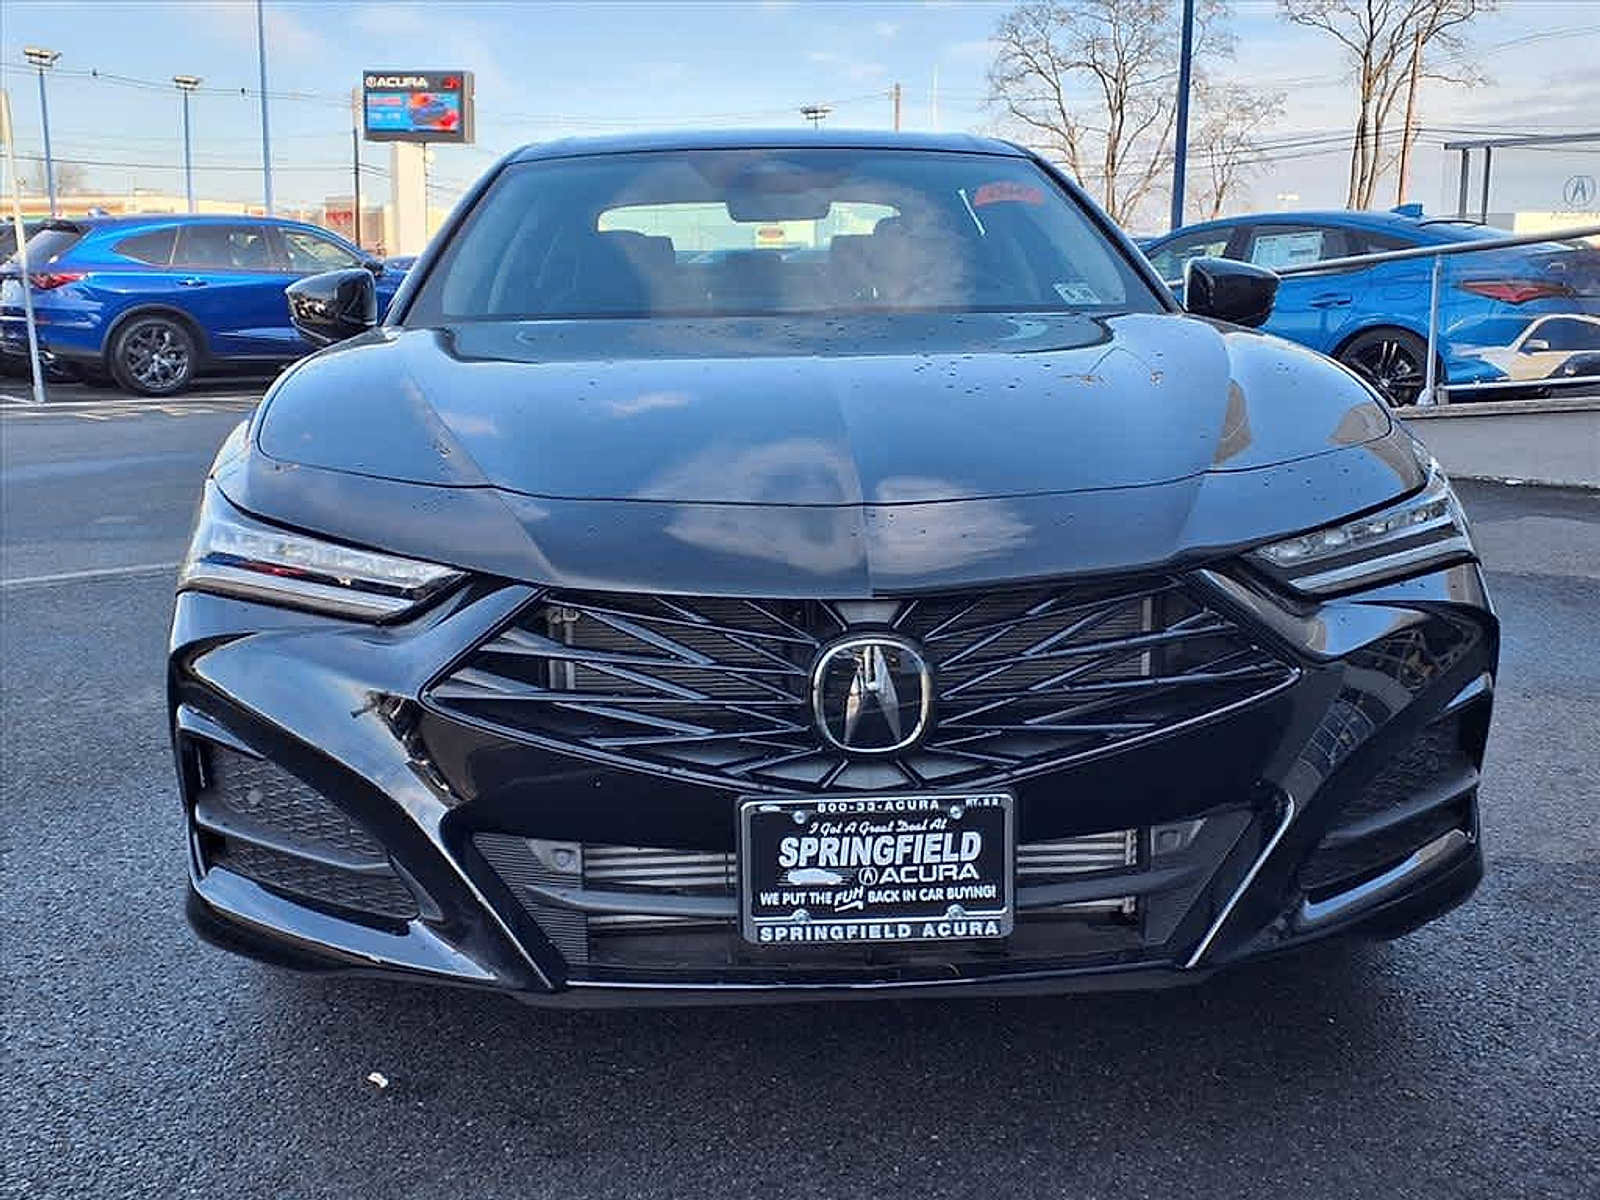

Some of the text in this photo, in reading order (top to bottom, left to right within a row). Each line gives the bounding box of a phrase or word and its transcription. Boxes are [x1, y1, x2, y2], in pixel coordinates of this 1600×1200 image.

[377, 76, 428, 88] ACURA
[844, 820, 857, 833] A
[859, 820, 894, 836] Great
[896, 818, 928, 832] Deal
[929, 818, 948, 831] At
[779, 832, 981, 867] SPRINGFIELD
[879, 863, 980, 884] ACURA
[760, 884, 998, 906] WE PUT THE FUN BACK IN CAR BUYING!
[760, 920, 999, 941] SPRINGFIELD ACURA
